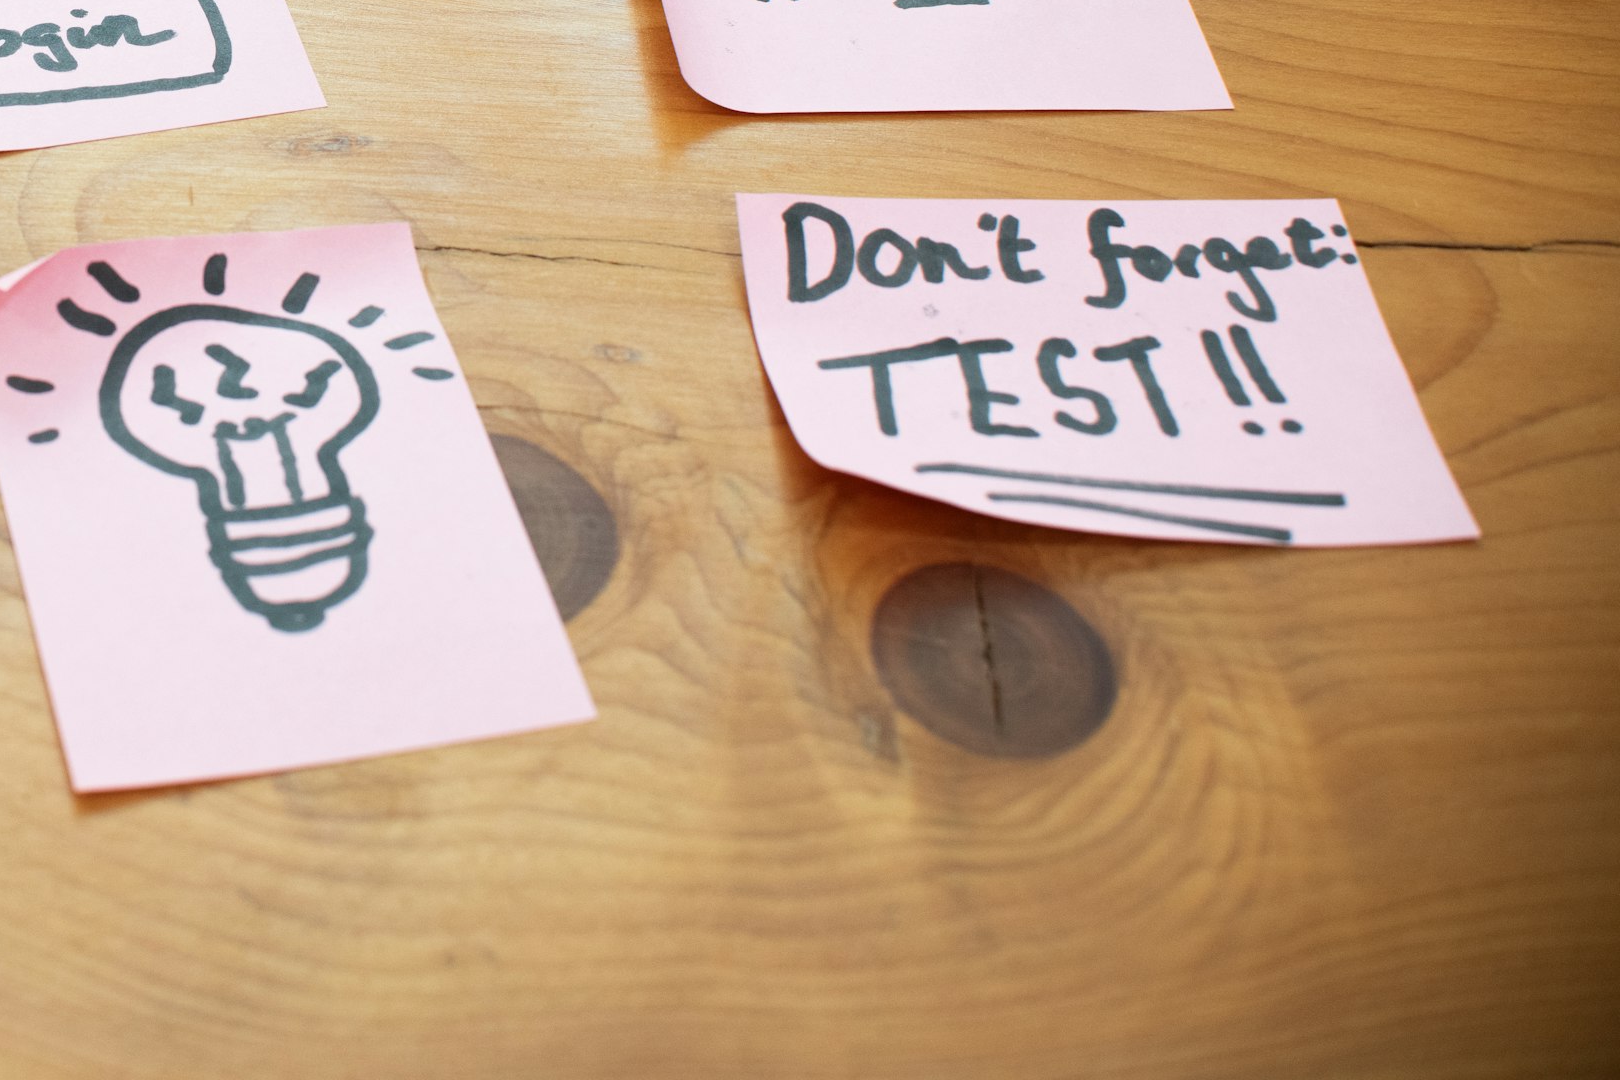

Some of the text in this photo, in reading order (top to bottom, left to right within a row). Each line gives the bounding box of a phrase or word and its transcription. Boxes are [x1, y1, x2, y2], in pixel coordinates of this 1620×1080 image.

[782, 201, 1359, 323] Don't forget:
[817, 324, 1305, 439] TEST!!
